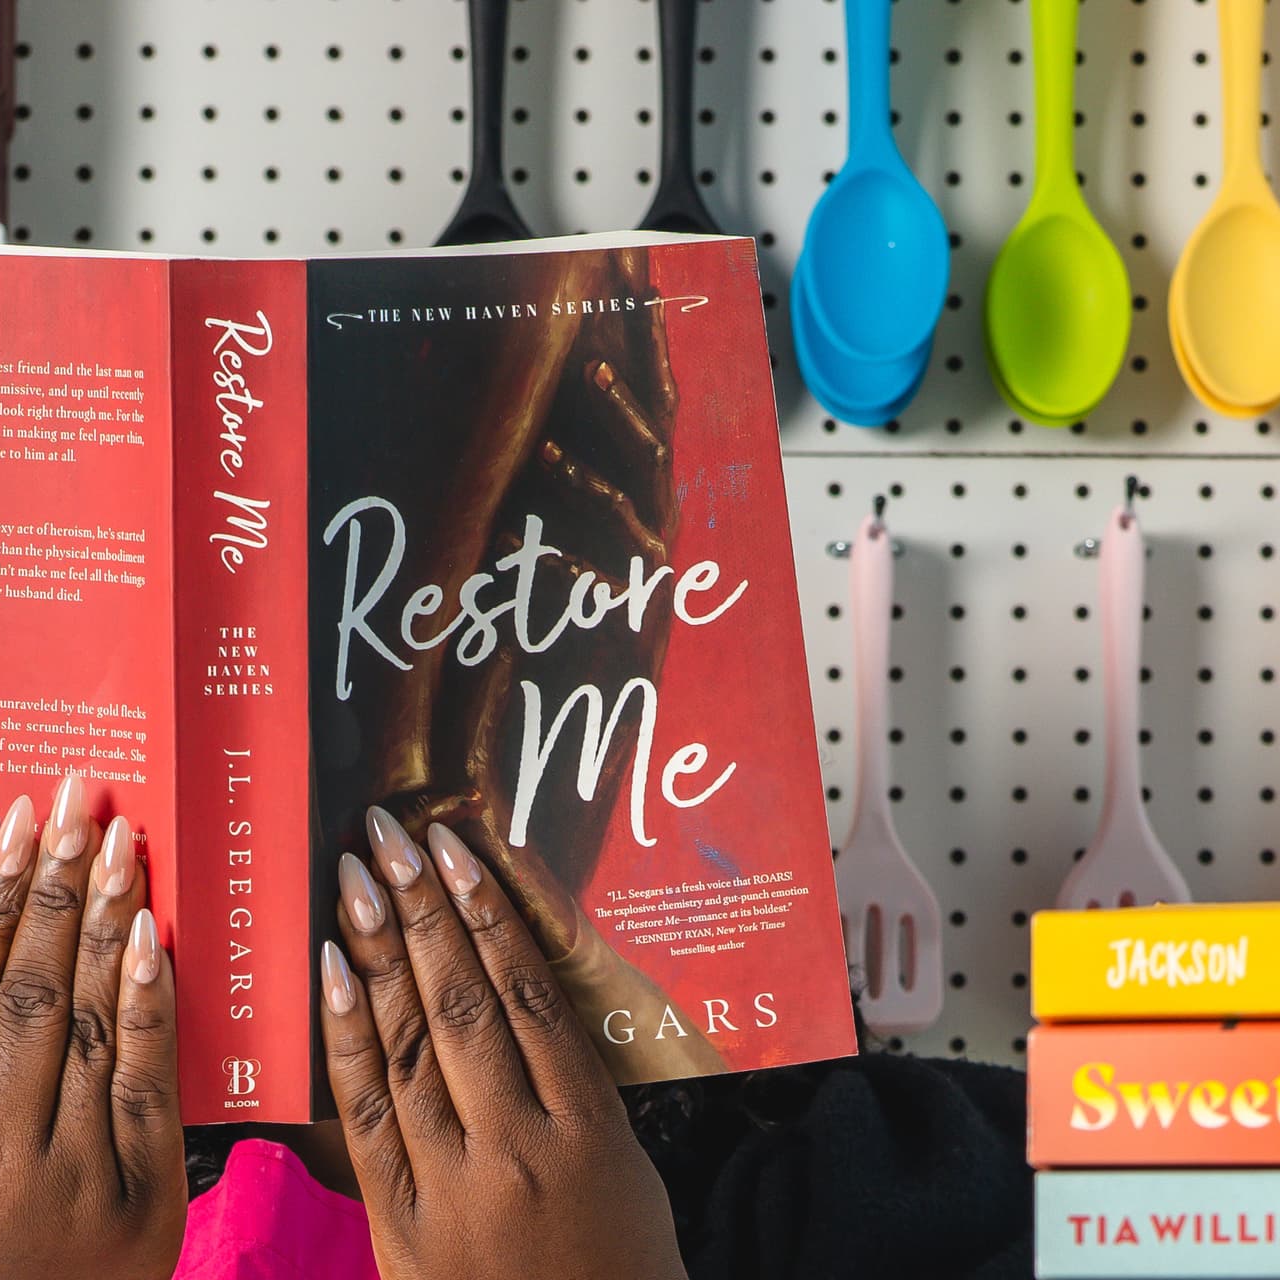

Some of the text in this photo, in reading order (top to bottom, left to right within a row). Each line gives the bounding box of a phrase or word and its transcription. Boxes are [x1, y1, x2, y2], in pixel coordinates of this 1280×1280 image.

[368, 296, 636, 323] THE NEW HAVEN SERIES
[17, 360, 50, 375] friend
[54, 362, 73, 376] and
[76, 363, 93, 377] the
[95, 364, 111, 377] last
[114, 369, 132, 378] man
[134, 370, 144, 379] on
[205, 310, 274, 575] Restore Me
[323, 494, 749, 701] Restore
[220, 627, 257, 639] THE
[218, 645, 259, 659] NEW
[208, 664, 271, 677] HAVEN
[204, 683, 274, 696] SERIES
[508, 676, 737, 848] Me
[223, 748, 253, 1020] J.L. SEEGARS
[628, 888, 664, 900] Seegars
[666, 886, 673, 895] is
[682, 881, 706, 894] fresh
[707, 879, 731, 890] voice
[733, 877, 751, 888] that
[753, 871, 793, 885] ROARS!
[595, 886, 809, 918] The explosive chemistry and gut-punch emotion
[616, 920, 625, 931] of
[627, 917, 663, 930] Restore
[730, 910, 739, 918] at
[740, 908, 752, 917] its
[685, 927, 714, 940] RYAN,
[716, 925, 736, 936] New
[738, 922, 758, 934] York
[760, 920, 785, 931] Times
[670, 940, 745, 957] bestselling author
[1106, 935, 1249, 990] JACKSON
[602, 992, 779, 1046] GARS
[224, 1100, 259, 1108] BLOOM
[1066, 1215, 1139, 1246] TIA
